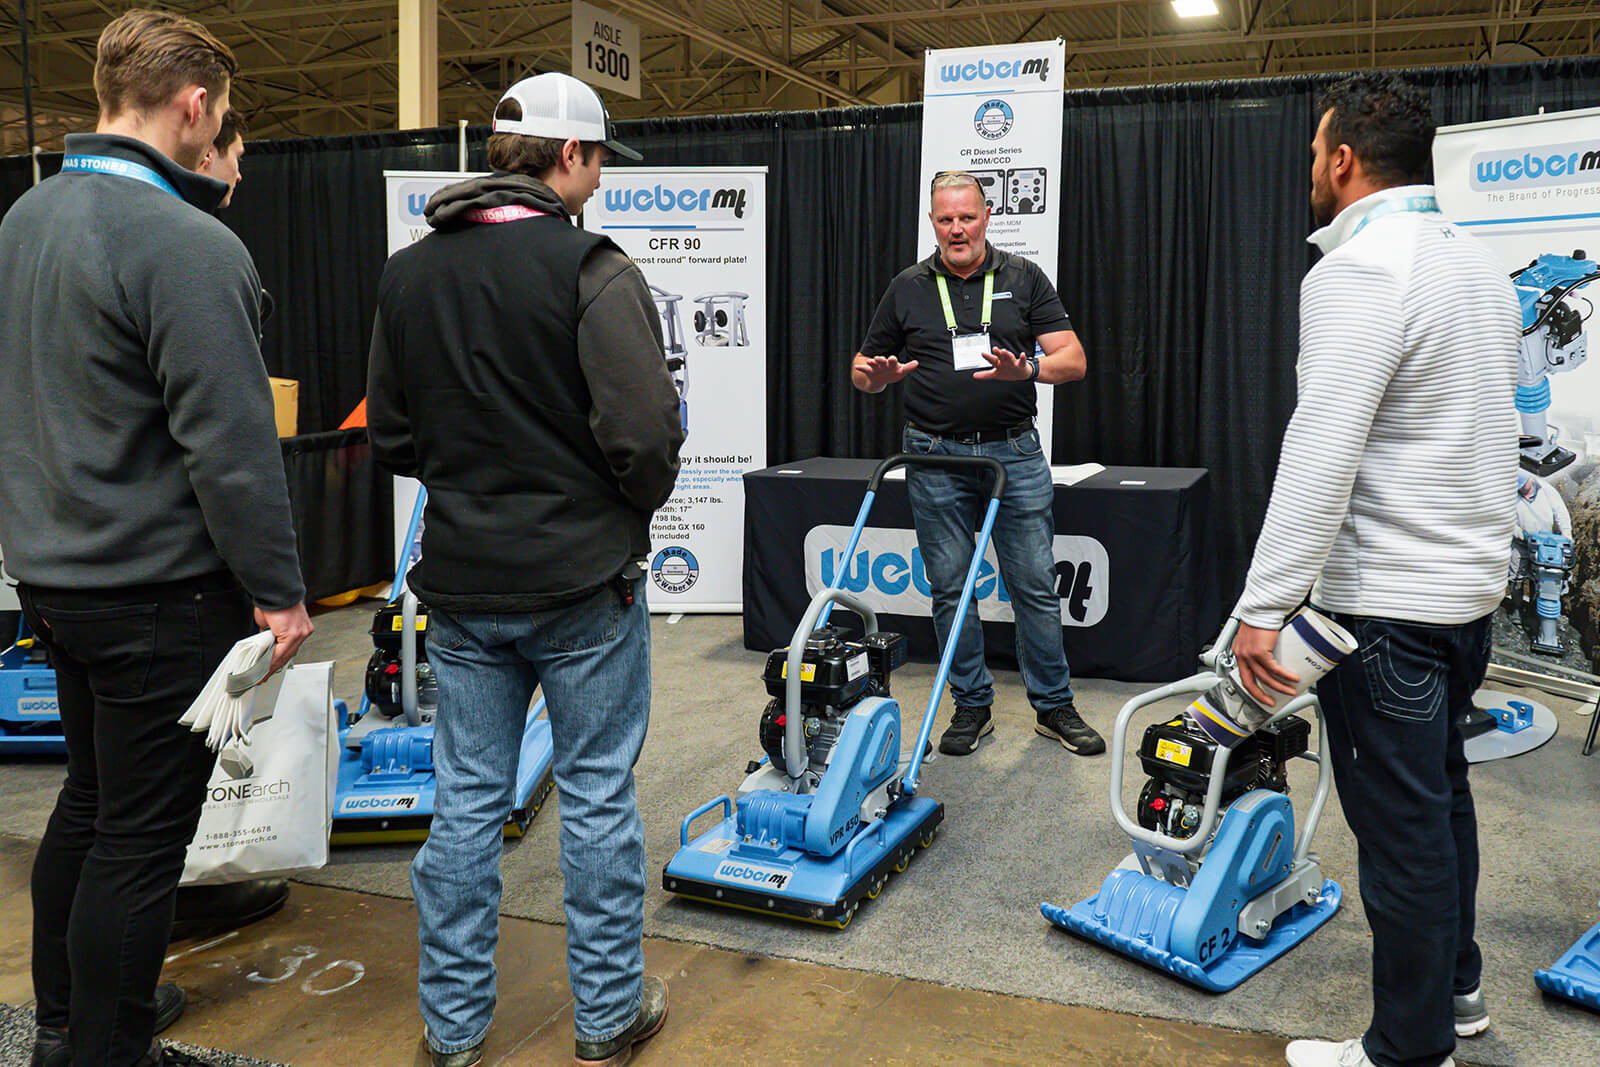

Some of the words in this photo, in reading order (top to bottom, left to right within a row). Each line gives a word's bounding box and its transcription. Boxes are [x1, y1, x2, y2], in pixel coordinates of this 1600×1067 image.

[593, 21, 621, 46] AISLE
[585, 41, 629, 81] 1300
[960, 148, 972, 156] CR
[973, 148, 997, 156] Diesel
[998, 147, 1022, 155] Series
[80, 159, 128, 172] STONES
[970, 157, 1011, 165] MDM/CCD
[1487, 193, 1504, 202] The
[1508, 191, 1537, 201] Brand
[1541, 189, 1551, 199] of
[649, 238, 679, 250] CFR
[684, 238, 701, 250] 90
[688, 256, 721, 264] forward
[723, 256, 747, 265] plate!
[662, 549, 688, 557] Made
[207, 779, 291, 802] ONEarch
[830, 825, 844, 846] VPR
[845, 813, 859, 832] 450
[1199, 936, 1216, 963] CF
[1221, 927, 1230, 949] 2
